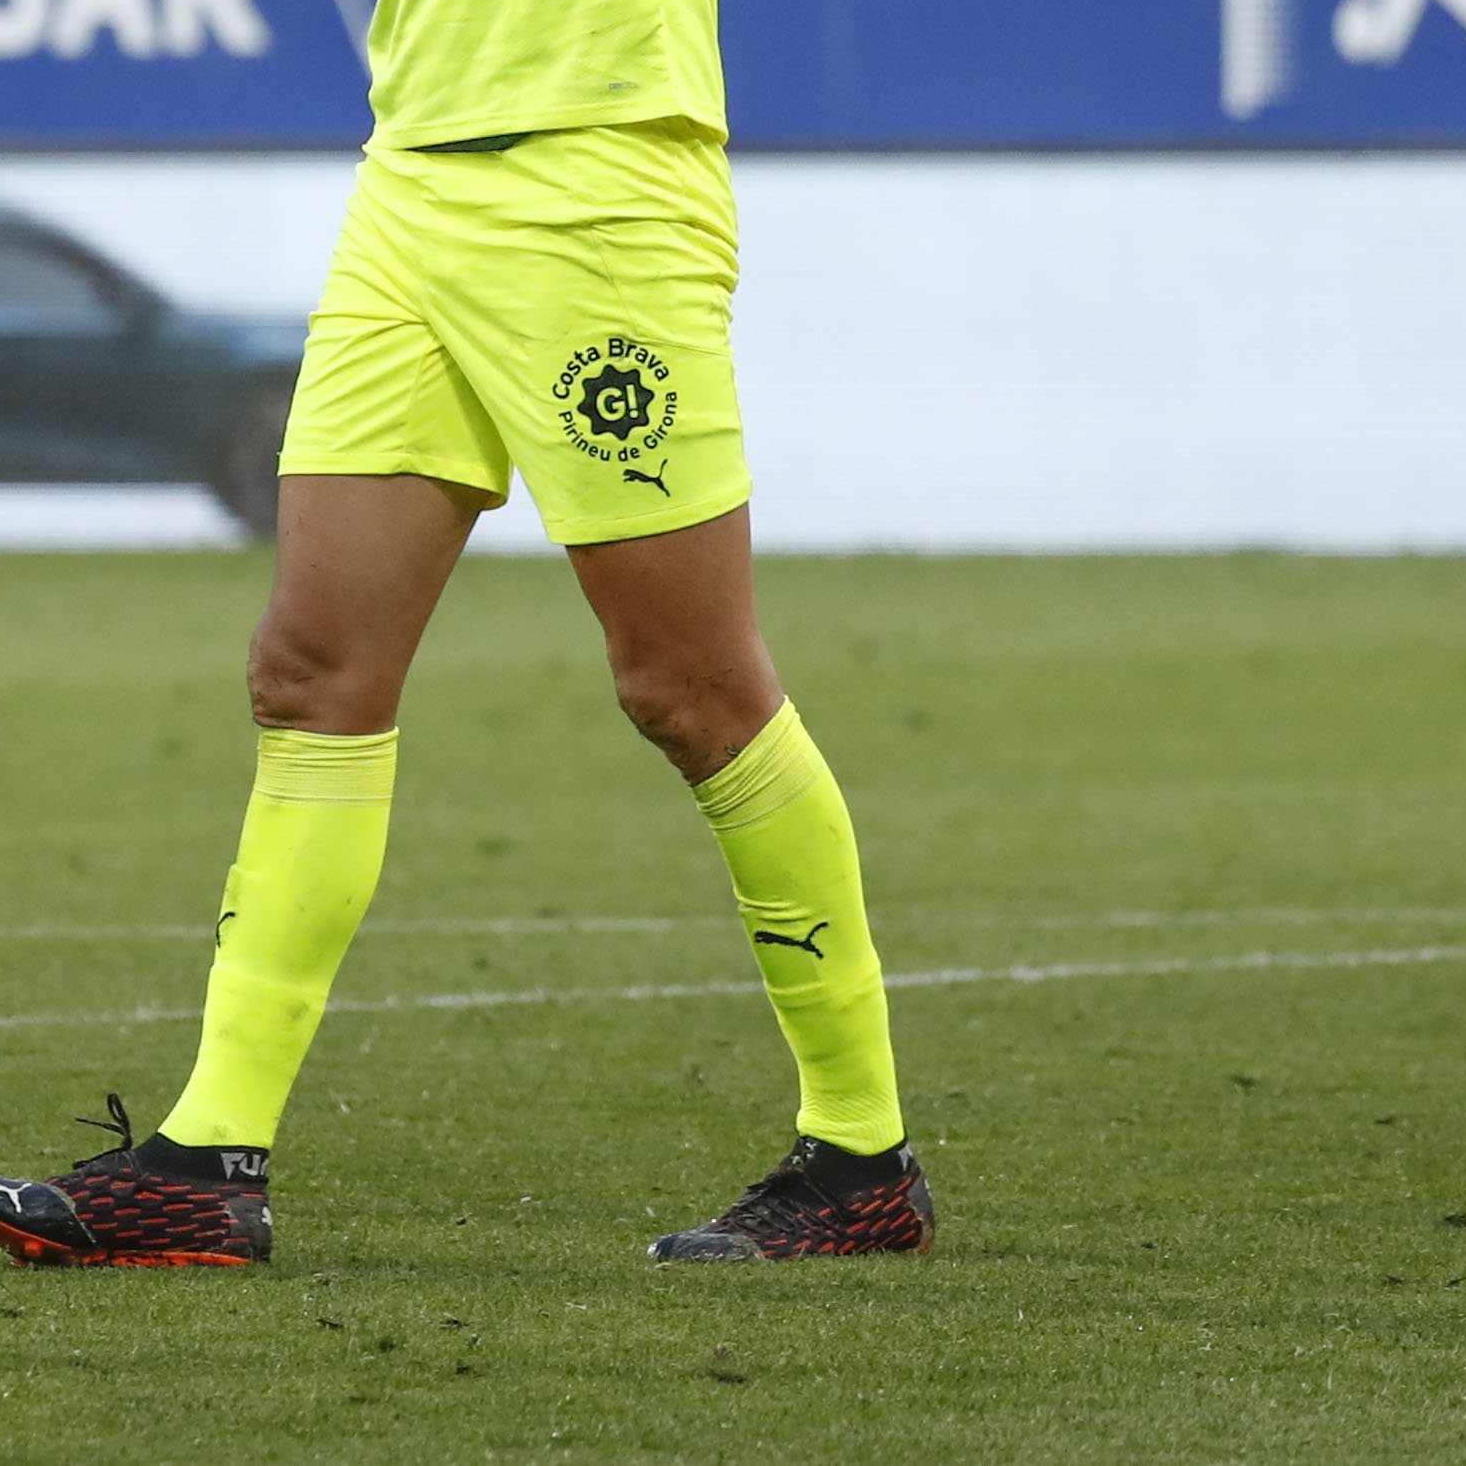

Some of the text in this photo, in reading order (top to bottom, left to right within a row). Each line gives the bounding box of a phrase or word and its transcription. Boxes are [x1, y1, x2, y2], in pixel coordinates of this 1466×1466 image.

[552, 337, 670, 400] Costa Brava
[558, 391, 678, 462] Pirineu de Girona
